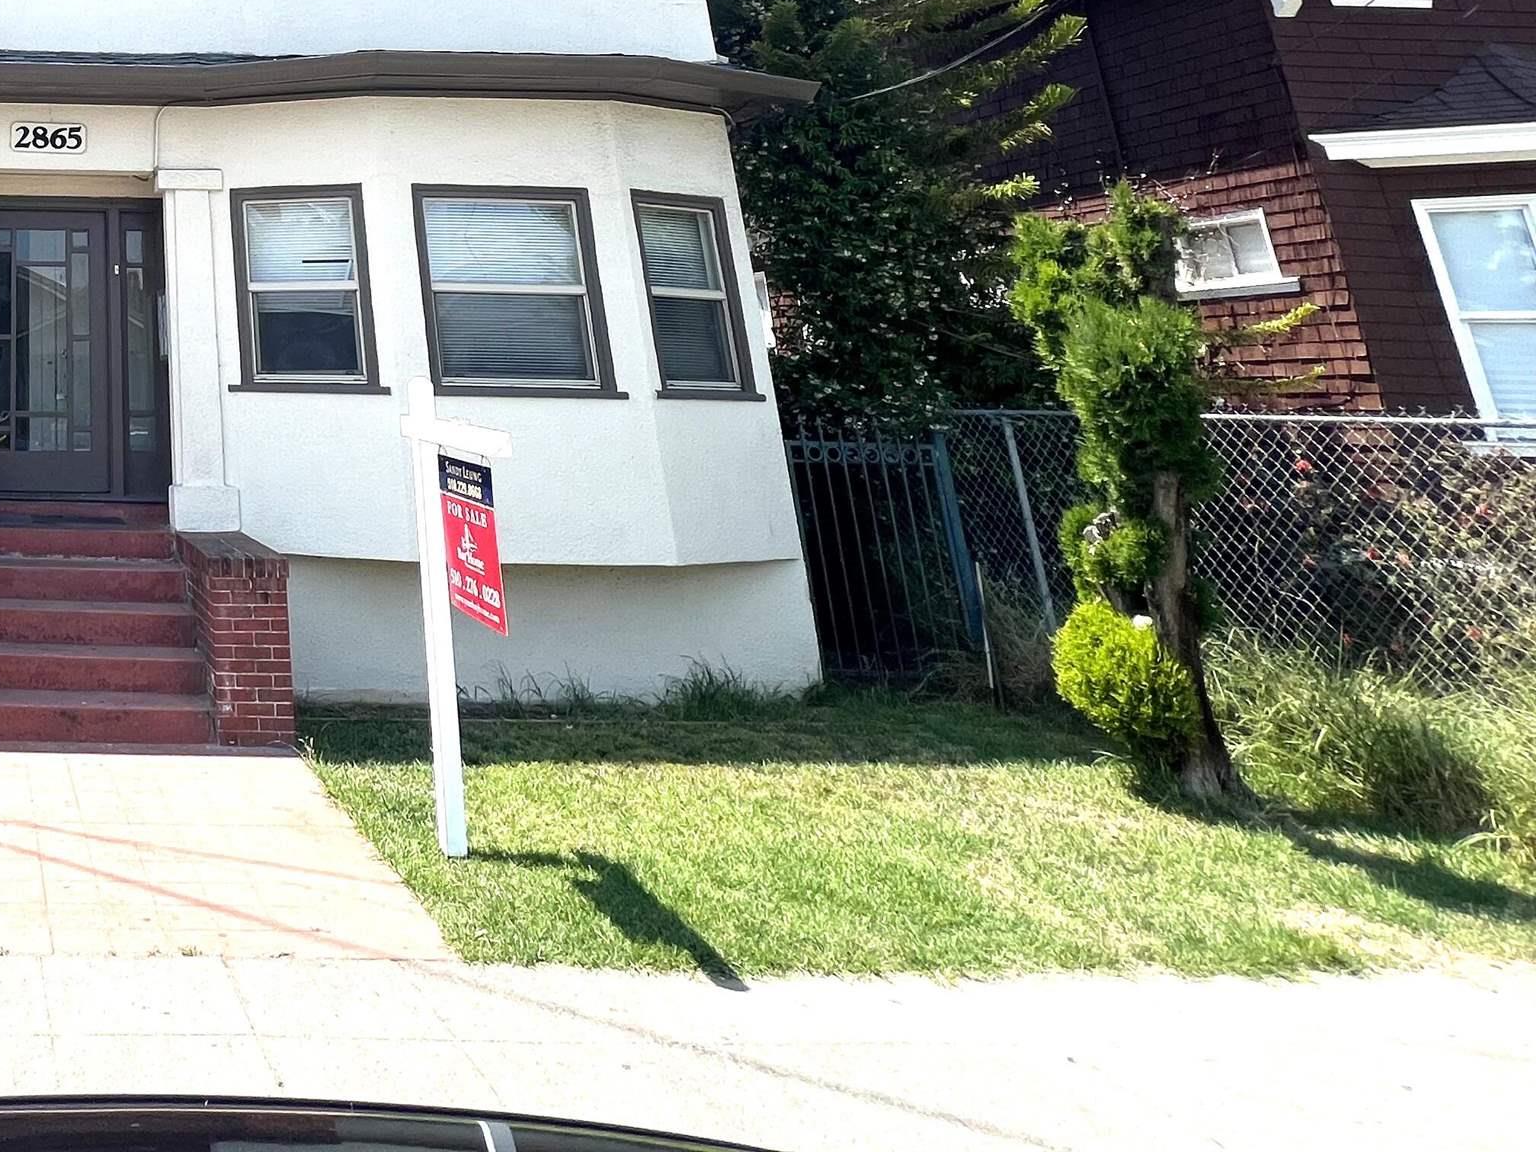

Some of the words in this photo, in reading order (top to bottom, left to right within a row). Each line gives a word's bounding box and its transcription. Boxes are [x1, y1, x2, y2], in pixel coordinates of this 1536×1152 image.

[14, 126, 83, 149] 2865
[447, 500, 464, 519] FOR
[464, 507, 488, 528] SALE
